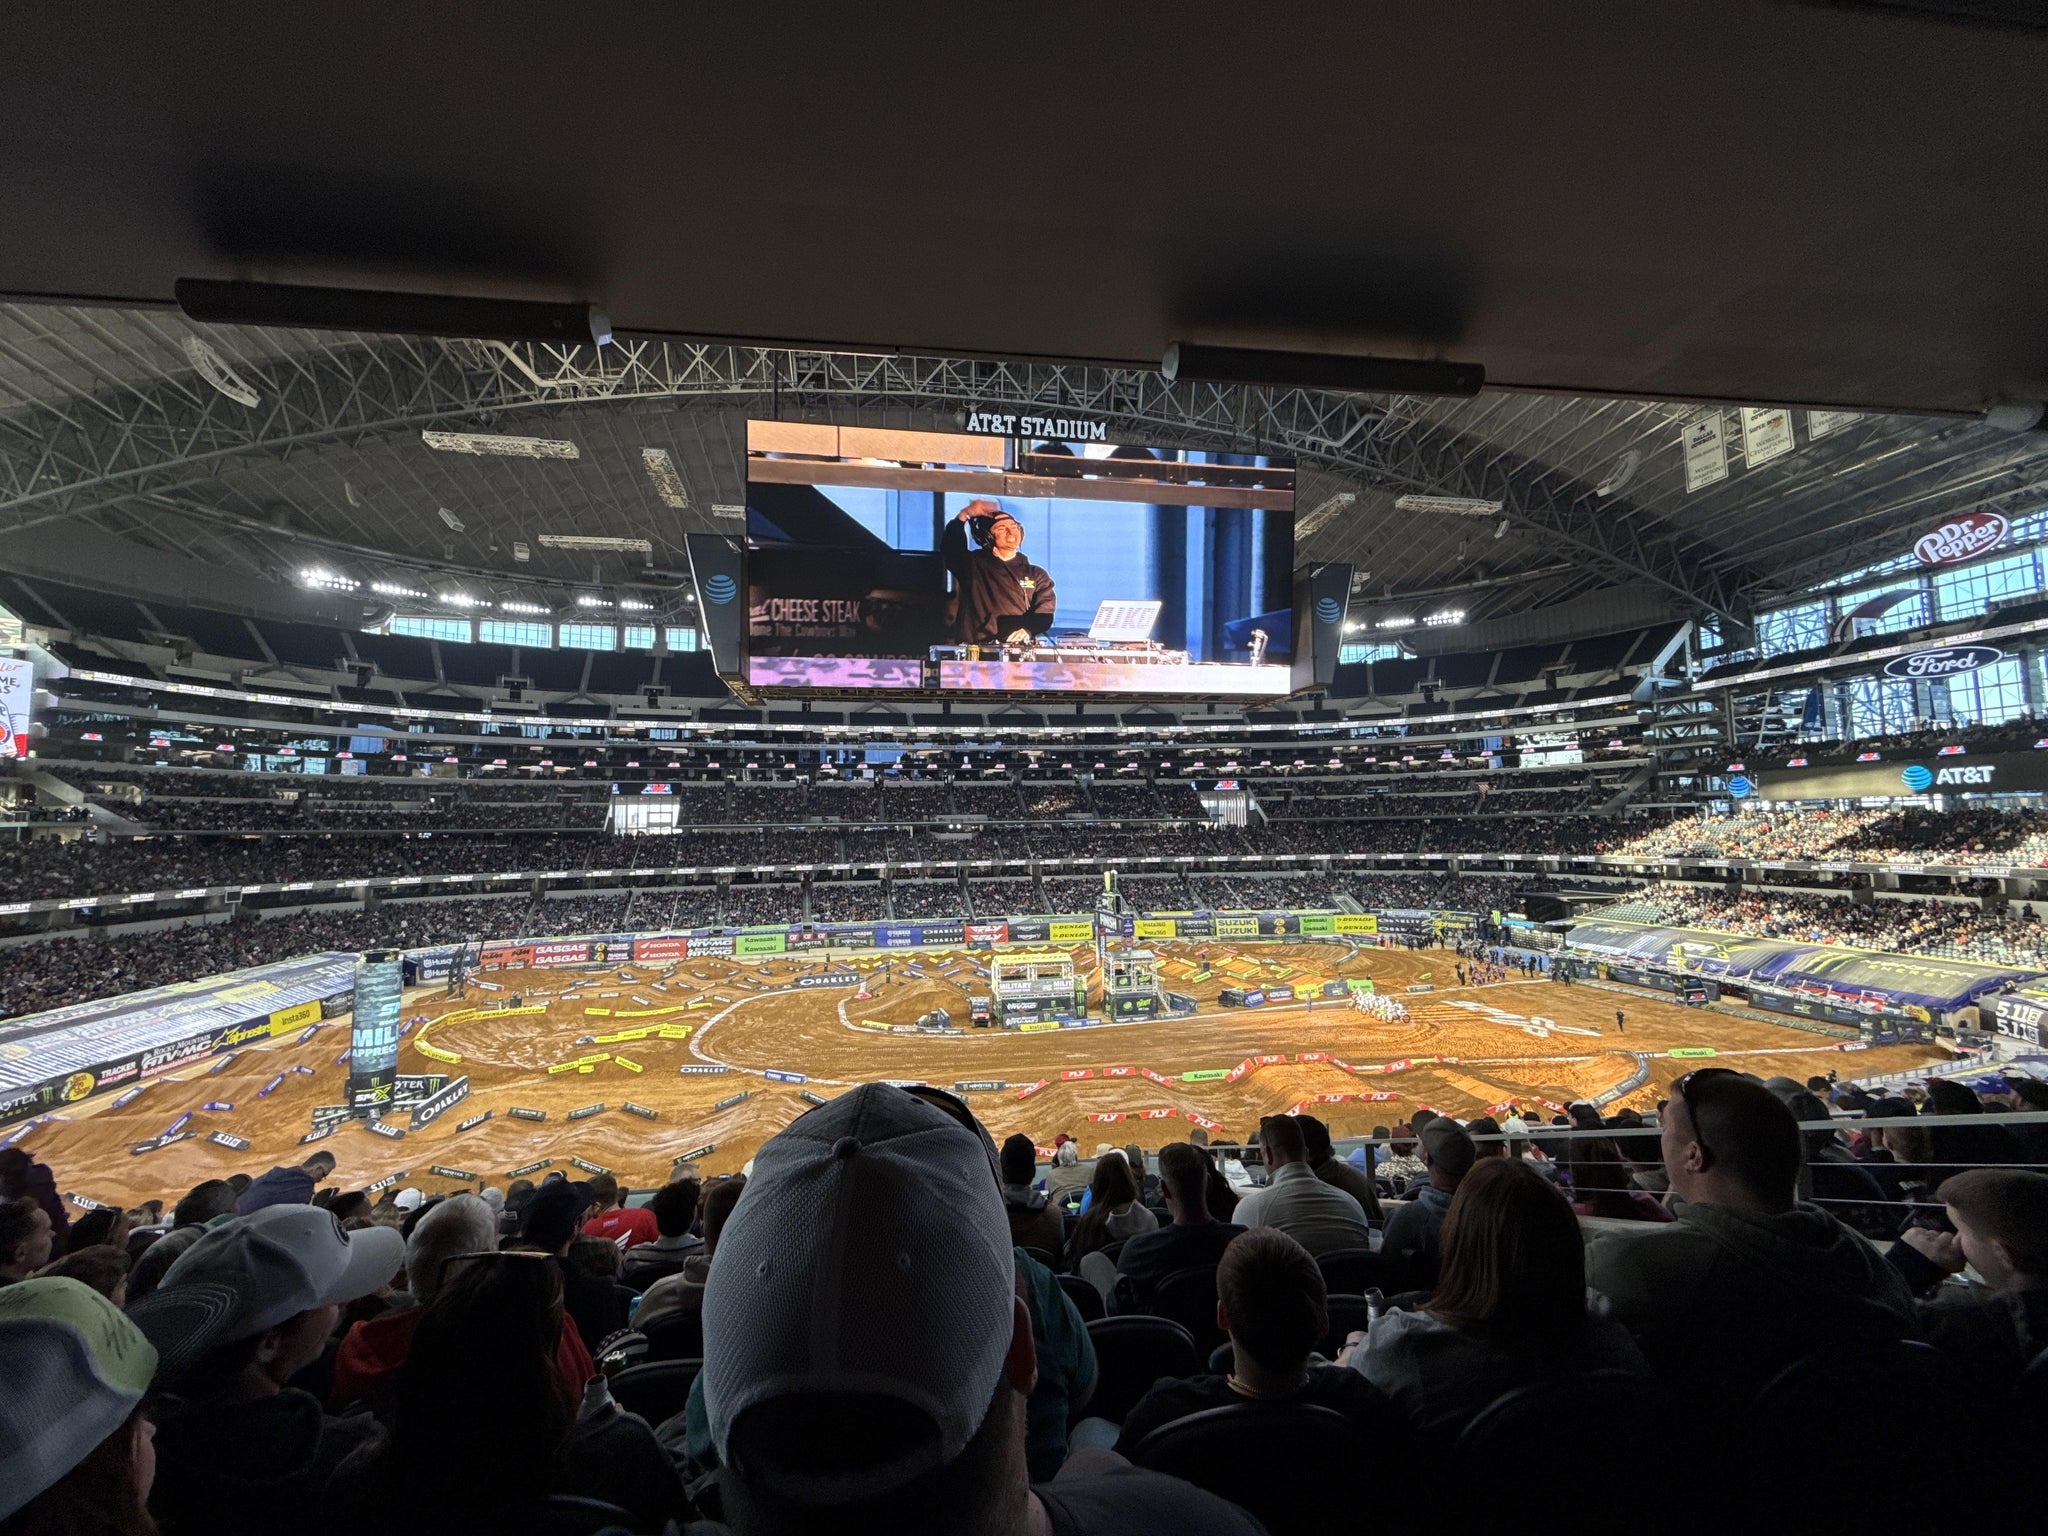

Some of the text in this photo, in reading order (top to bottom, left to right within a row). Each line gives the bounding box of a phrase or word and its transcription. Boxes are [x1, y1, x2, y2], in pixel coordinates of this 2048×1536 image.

[967, 413, 1106, 440] AT&T STADIUM
[1690, 434, 1716, 449] COWBOYS
[1693, 430, 1713, 443] DALLAS
[1756, 434, 1780, 448] WORLD
[1750, 437, 1788, 458] CHAMPIONS
[1690, 465, 1724, 482] CHAMPIONS
[1694, 462, 1717, 474] WORLD
[1938, 520, 1974, 543] Dr
[1922, 520, 2000, 563] Pepper
[771, 598, 819, 622] CHEESE
[822, 600, 860, 623] STEAK
[1946, 632, 1983, 643] MILITARY
[1869, 647, 1901, 657] MILITARY
[1907, 652, 1978, 676] Ford
[94, 672, 134, 682] MILITARY
[178, 684, 216, 694] MILITARY
[257, 694, 292, 702] MILITARY
[332, 702, 363, 710] MILITARY
[1936, 766, 1995, 785] AT&T
[1890, 866, 1924, 874] MILITARY
[1971, 868, 2010, 876] MILITARY
[70, 898, 98, 906] MILITARY
[536, 944, 587, 954] GASGAS
[536, 954, 586, 964] GASGAS
[816, 976, 858, 984] OAKLEY
[282, 1009, 311, 1025] Insta360
[1996, 1002, 2028, 1021] 5.11
[1997, 1018, 2028, 1038] 5.11
[228, 1024, 271, 1046] alpinestars
[154, 1034, 211, 1056] ROCKY MOUNTAIN
[1304, 1053, 1319, 1061] FLY
[102, 1061, 136, 1078] TRACKER
[1111, 1068, 1128, 1076] FLY
[1231, 1064, 1246, 1078] FLY
[1390, 1062, 1406, 1071] FLY
[1150, 1072, 1166, 1082] FLY
[1194, 1071, 1222, 1079] Kawasaki
[355, 1086, 392, 1102] SMX
[1024, 1083, 1038, 1094] FLY
[434, 1083, 468, 1112] OAKLEY
[1325, 1094, 1344, 1102] FLY
[1372, 1092, 1390, 1100] FLY
[1495, 1102, 1511, 1112] FLY
[1544, 1101, 1560, 1110] FLY
[1097, 1113, 1118, 1122] FLY
[1150, 1109, 1170, 1118] FLY
[1195, 1117, 1215, 1128] FLY
